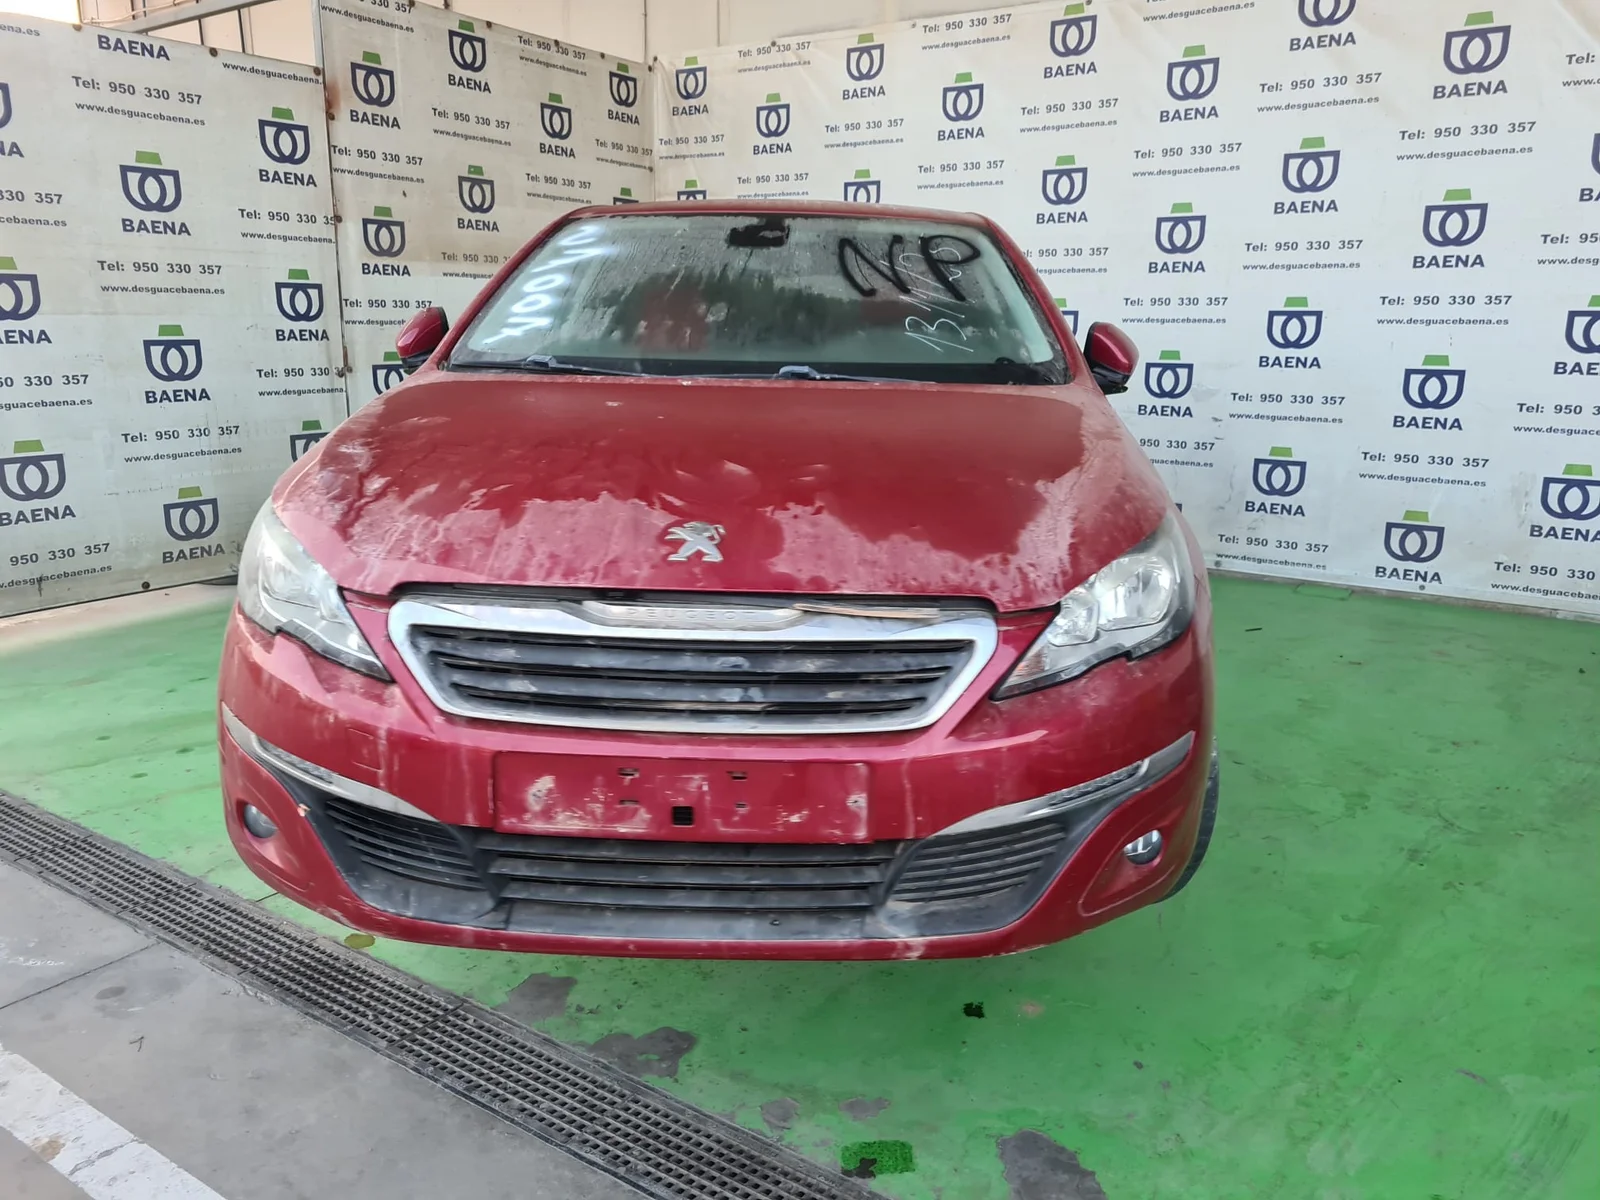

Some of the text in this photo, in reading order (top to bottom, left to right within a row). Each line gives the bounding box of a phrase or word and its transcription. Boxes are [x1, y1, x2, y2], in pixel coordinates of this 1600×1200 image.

[1142, 2, 1255, 22] www.desguacebaena.es
[922, 13, 1012, 34] Tel: 950 330 357
[97, 34, 171, 61] BAENA
[1289, 31, 1356, 52] BAENA
[1043, 61, 1098, 79] BAENA
[71, 75, 202, 105] Tel: 950 330 357
[448, 73, 492, 94] BAENA
[1259, 72, 1382, 93] Tel: 950 330 357
[1432, 79, 1508, 100] BAENA
[842, 85, 886, 101] BAENA
[672, 104, 709, 117] BAENA
[1020, 98, 1119, 116] Tel: 950 330 357
[1257, 96, 1379, 113] www.desguacebaena.es
[75, 102, 205, 126] www.desguacebaena.es
[350, 109, 401, 130] BAENA
[431, 107, 510, 130] Tel: 950 330 357
[607, 109, 640, 126] BAENA
[1159, 105, 1219, 123] BAENA
[825, 118, 904, 133] Tel: 950 330 357
[1020, 120, 1117, 133] www.desguacebaena.es
[1399, 121, 1537, 141] Tel: 950 330 357
[937, 126, 985, 142] BAENA
[331, 144, 423, 166] Tel: 950 330 357
[539, 142, 576, 159] BAENA
[753, 142, 792, 155] BAENA
[1133, 142, 1242, 159] Tel: 950 330 357
[1396, 147, 1533, 161] www.desguacebaena.es
[917, 160, 1005, 174] Tel: 950 330 357
[1132, 165, 1240, 177] www.desguacebaena.es
[258, 168, 318, 188] BAENA
[333, 167, 425, 184] www.desguacebaena.es
[737, 172, 809, 184] Tel: 950 330 357
[917, 180, 1004, 190] www.desguacebaena.es
[1273, 199, 1339, 215] BAENA
[238, 208, 317, 224] Tel: 950 330
[1036, 211, 1088, 225] BAENA
[121, 218, 192, 236] BAENA
[457, 217, 500, 233] BAENA
[1038, 247, 1109, 258] 950 330 357
[1244, 239, 1363, 252] Tel: 950 330 357
[96, 260, 222, 275] Tel: 950 330 357
[361, 262, 411, 277] BAENA
[1148, 260, 1206, 274] BAENA
[1242, 262, 1360, 271] www.desguacebaena.es
[1412, 254, 1485, 269] BAENA
[100, 284, 225, 295] www.desguacebaena.es
[342, 298, 434, 310] Tel: 950 330 357
[1123, 297, 1228, 306] Tel: 950 330 357
[1379, 295, 1512, 306] Tel: 950 330 357
[1122, 316, 1226, 325] www.desguacebaena.es
[1377, 317, 1509, 327] www.desguacebaena.es
[275, 328, 330, 342] BAENA
[1258, 355, 1321, 369] BAENA
[256, 366, 331, 378] Tel: 950 330
[23, 375, 53, 387] 330
[61, 374, 89, 385] 357
[144, 388, 211, 404] BAENA
[1230, 392, 1346, 406] Tel: 950 330 357
[1137, 404, 1193, 418] BAENA
[1229, 413, 1343, 424] www.desguacebaena.es
[1392, 415, 1463, 431] BAENA
[121, 425, 240, 443] Tel: 950 330 357
[1139, 438, 1215, 451] 950 330 357
[124, 447, 242, 463] www.desguacebaena.es
[1361, 451, 1490, 468] Tel: 950 330 357
[1358, 473, 1486, 487] www.desguacebaena.es
[0, 505, 76, 527] BAENA
[1244, 500, 1306, 517] BAENA
[1218, 534, 1329, 553] Tel: 950 330 357
[9, 542, 110, 566] 950 330 357
[162, 543, 225, 564] BAENA
[1217, 553, 1326, 570] www.desguacebaena.es
[1375, 565, 1443, 585] BAENA
[1494, 561, 1596, 581] Tel: 950 330
